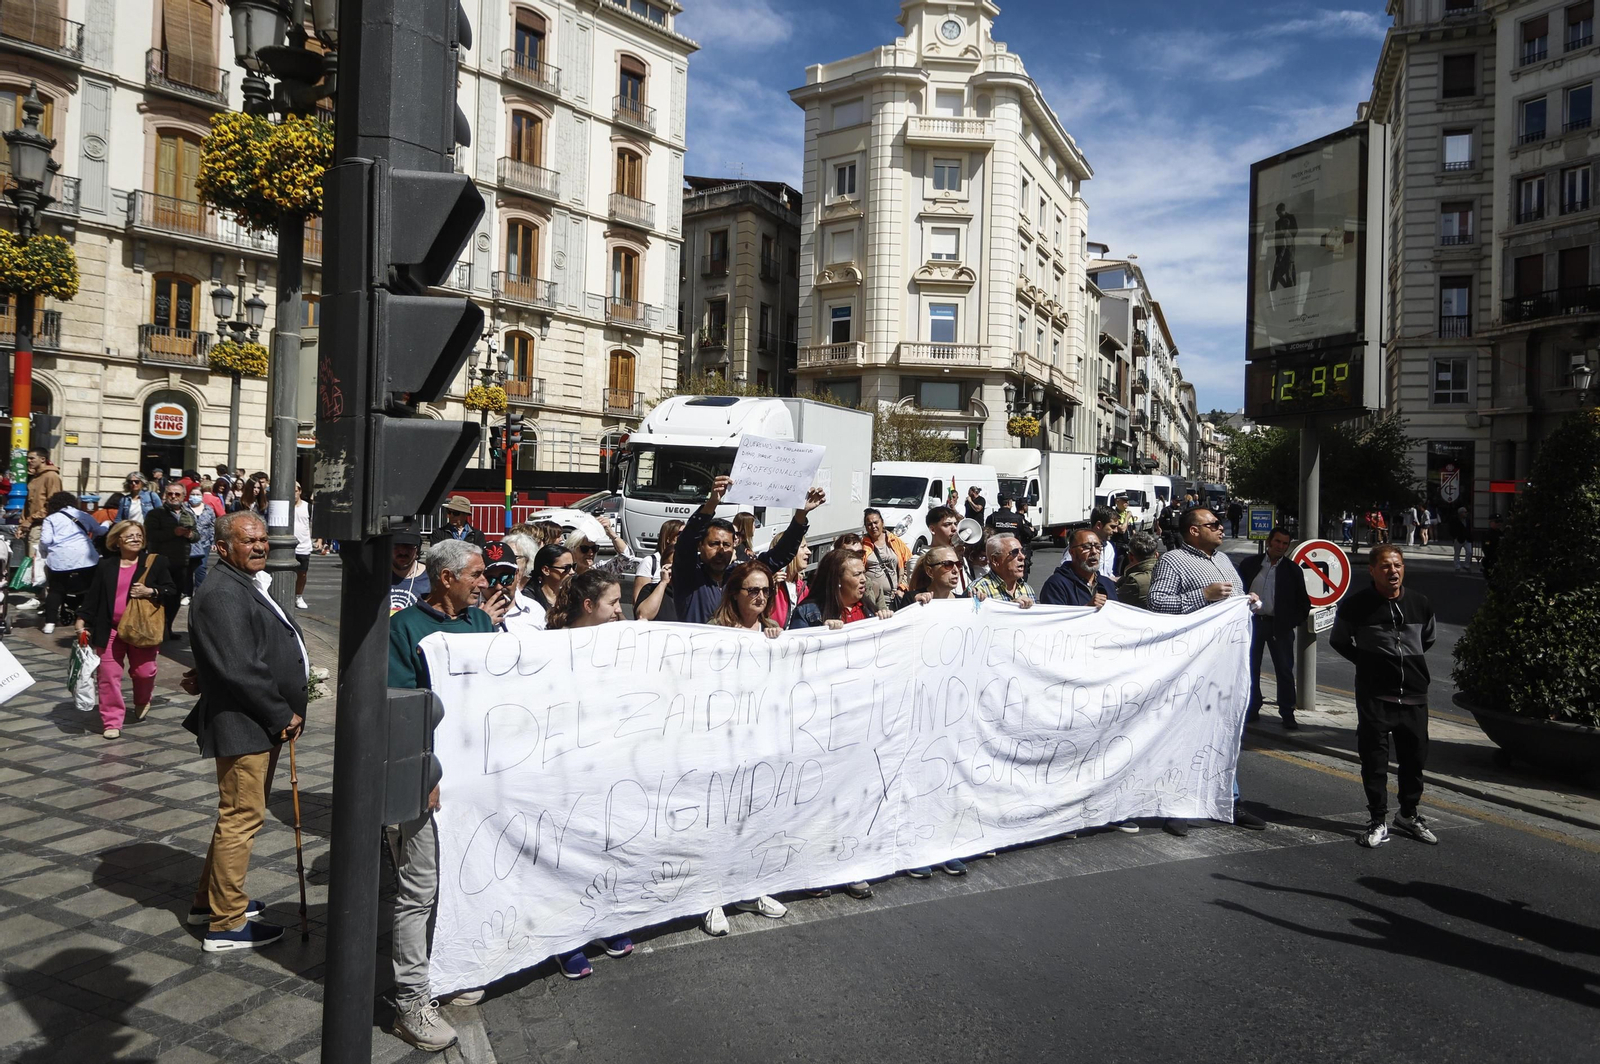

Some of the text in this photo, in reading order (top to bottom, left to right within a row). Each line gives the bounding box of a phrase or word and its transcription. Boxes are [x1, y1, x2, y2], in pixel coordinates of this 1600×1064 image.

[154, 414, 184, 423] BURGER
[154, 420, 184, 431] KING
[774, 456, 796, 464] SOMOS
[740, 462, 803, 478] PROFESIONALES
[744, 480, 763, 488] SOMOS
[665, 506, 691, 514] IVECO
[569, 627, 822, 677] PLATAFORMA
[845, 628, 896, 670] DE
[920, 622, 1126, 668] COMERCIANTES
[481, 701, 600, 775] DEL
[613, 684, 768, 739] ZAIDIN
[1045, 672, 1205, 732] TRABAJAR
[459, 735, 1134, 896] CON DIGNIDAD Y SEGURIDAD
